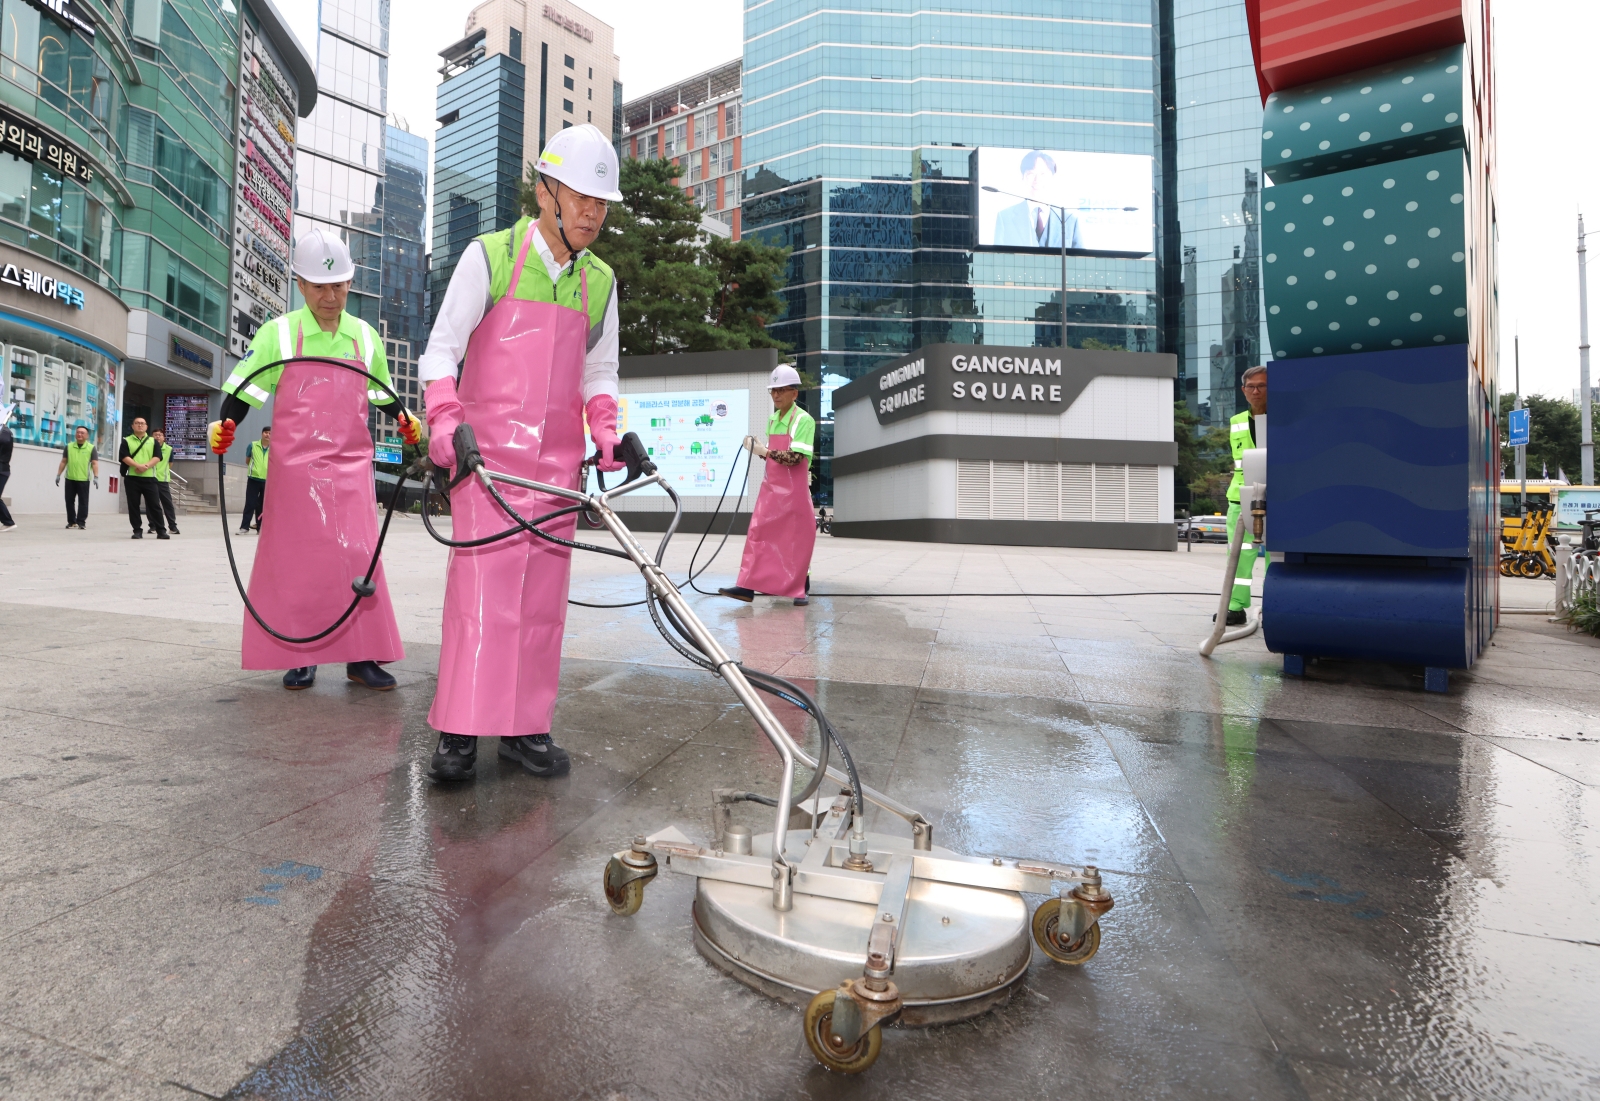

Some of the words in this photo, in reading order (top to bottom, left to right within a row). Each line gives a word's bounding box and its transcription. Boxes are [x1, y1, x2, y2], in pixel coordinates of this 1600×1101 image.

[47, 144, 77, 177] 의원
[80, 165, 94, 182] 2F
[0, 263, 85, 311] 스퀘어약국
[879, 358, 925, 391] GANGNAM
[951, 354, 1062, 376] GANGNAM
[879, 384, 925, 415] SQUARE
[952, 381, 1062, 402] SQUARE
[1523, 410, 1529, 420] P
